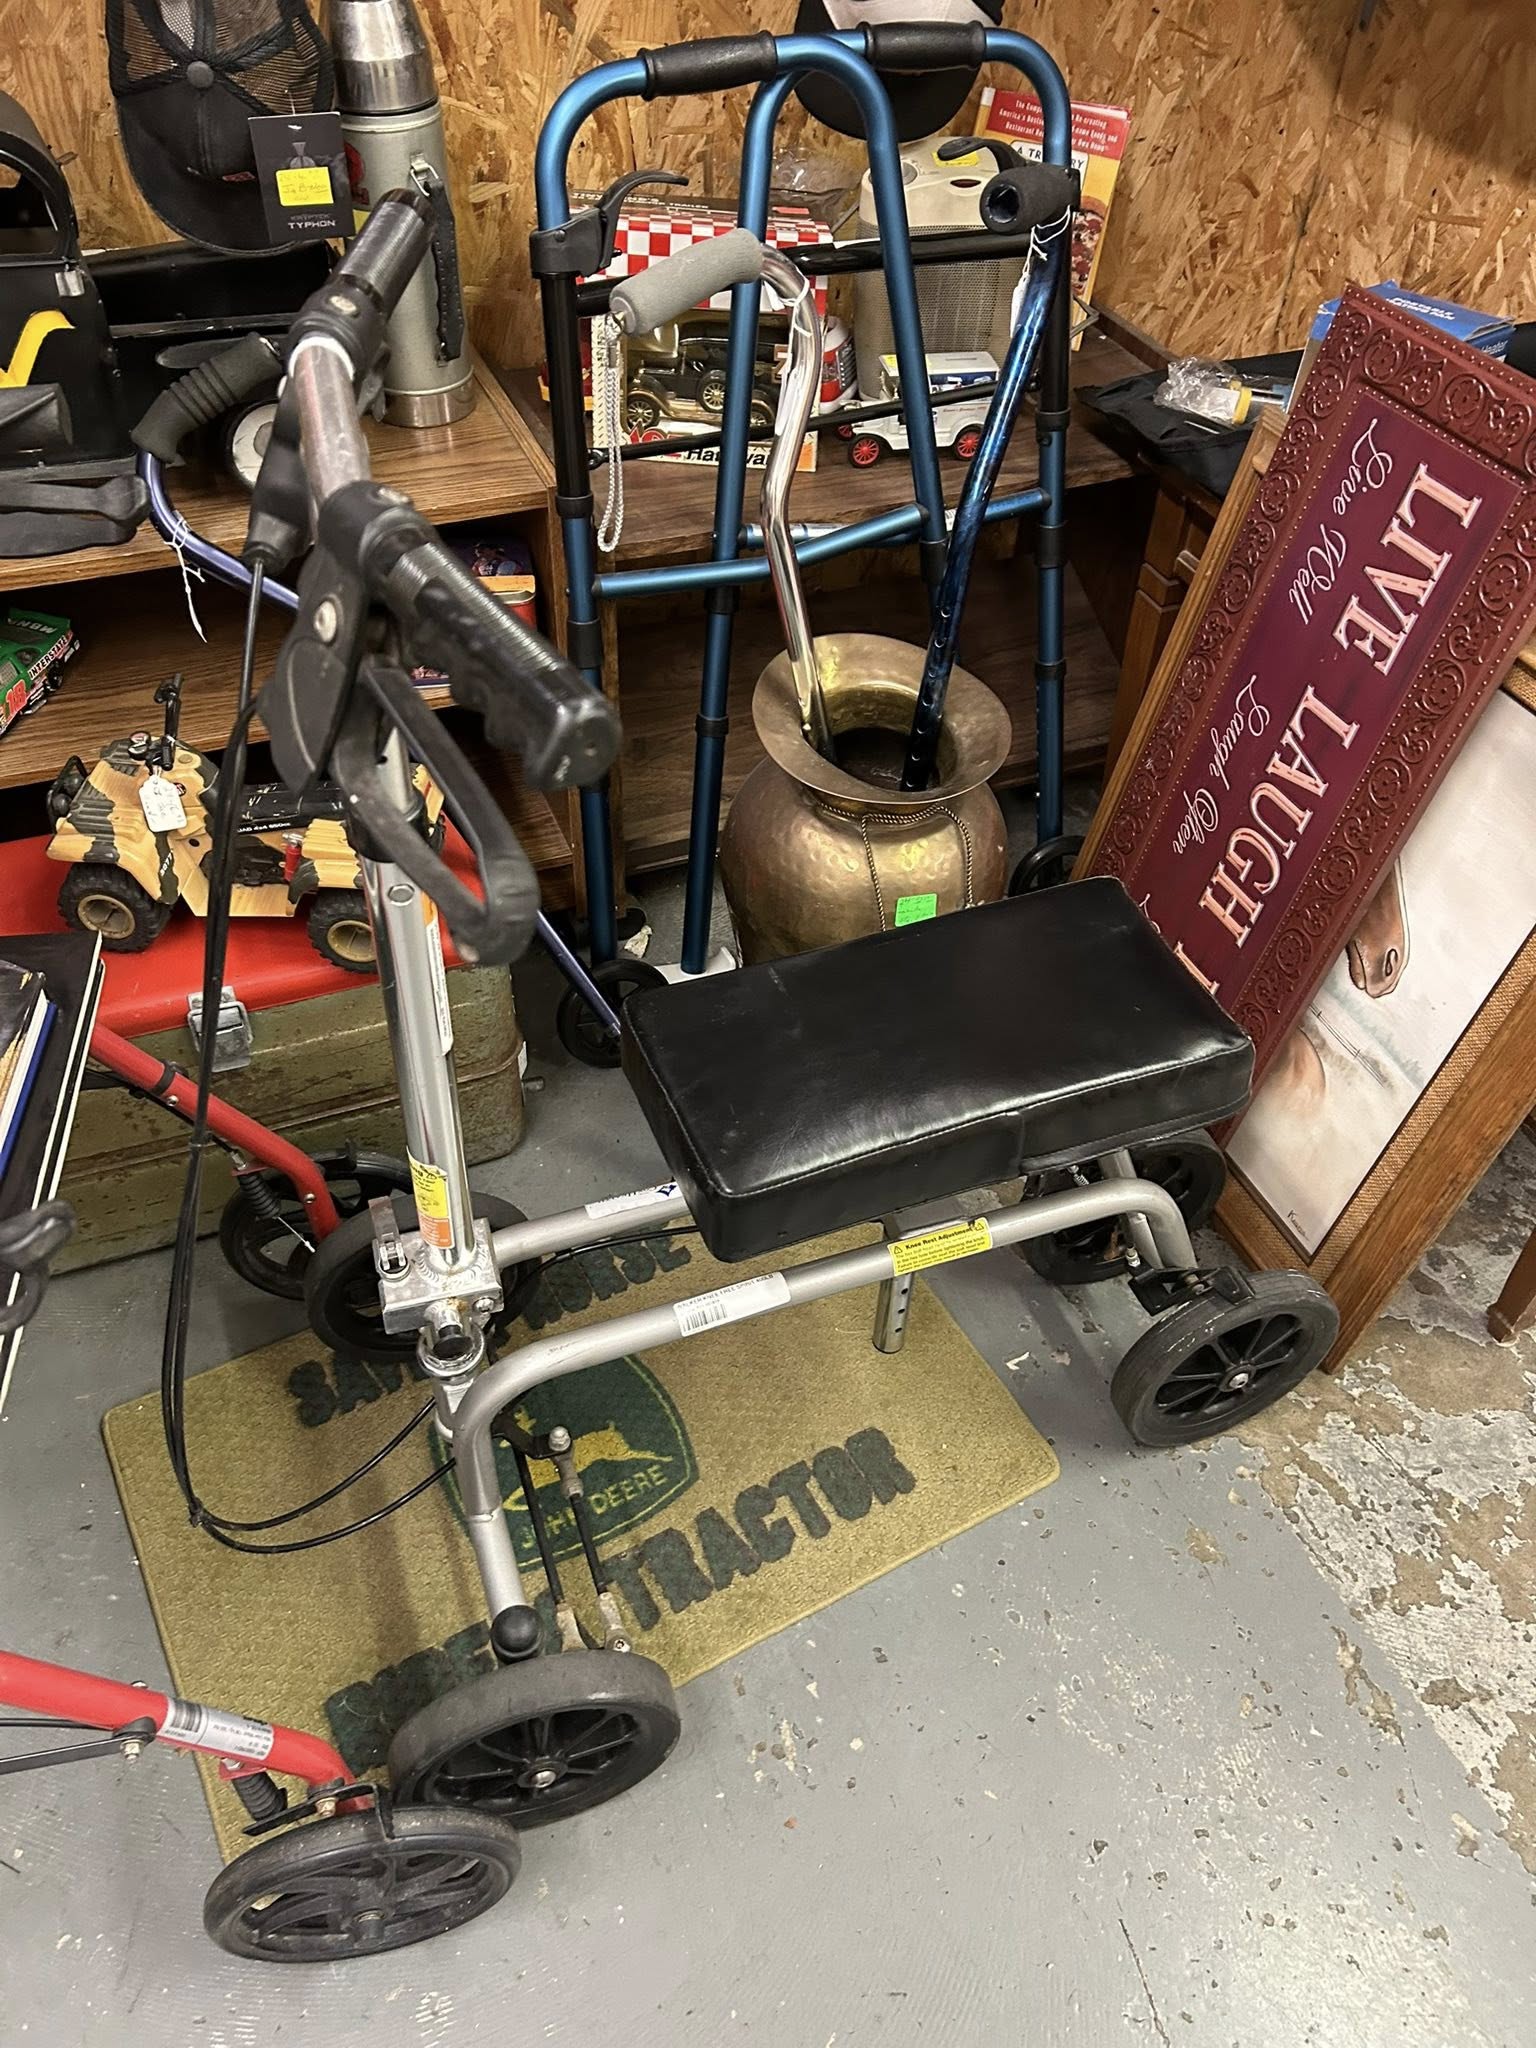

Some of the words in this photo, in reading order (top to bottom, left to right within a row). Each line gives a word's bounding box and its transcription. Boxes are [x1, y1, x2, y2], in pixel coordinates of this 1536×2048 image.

[1028, 147, 1085, 169] TRRY
[288, 219, 336, 229] TYPHON
[1333, 419, 1393, 516] Live
[1290, 524, 1347, 625] Well
[1332, 463, 1482, 676] LIVE
[28, 634, 69, 680] INTERSTATE
[1210, 675, 1270, 790] Laugh
[1173, 788, 1219, 854] Often
[1199, 685, 1360, 948] LAUGH
[905, 1242, 922, 1250] Knee
[922, 1237, 938, 1245] Rest
[938, 1227, 973, 1241] Adjustment
[588, 1464, 668, 1515] DEERE
[601, 1427, 917, 1631] TRACTOR
